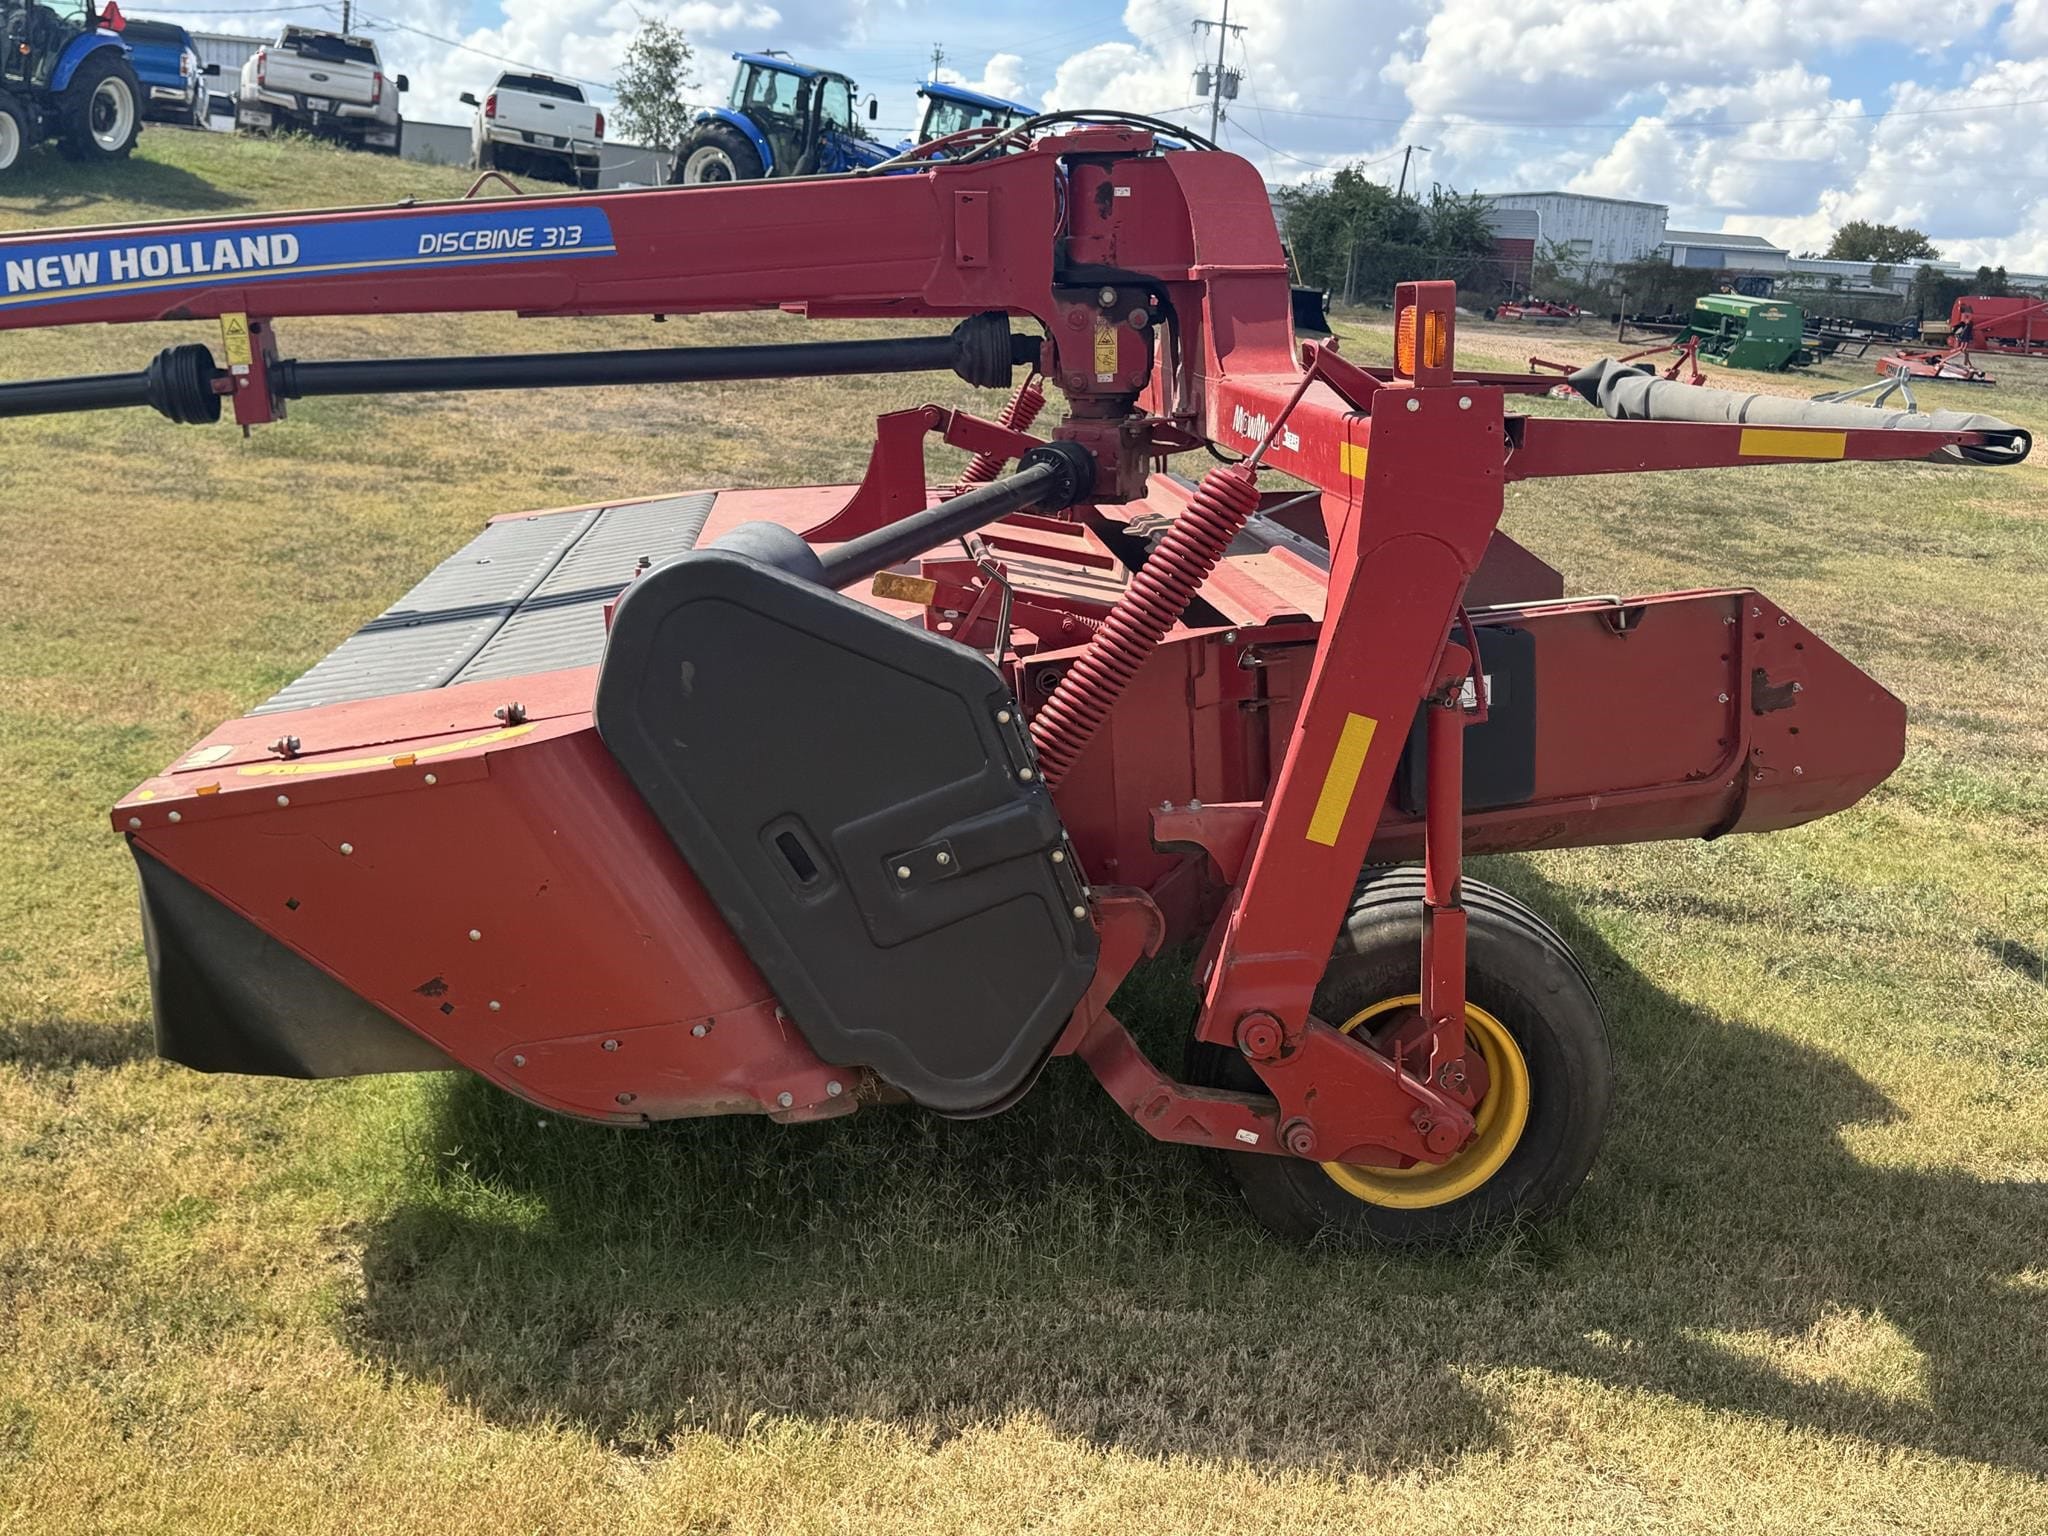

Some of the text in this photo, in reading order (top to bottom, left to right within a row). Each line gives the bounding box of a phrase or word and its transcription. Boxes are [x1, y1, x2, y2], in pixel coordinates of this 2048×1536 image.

[418, 225, 583, 254] DISCBINE 313
[6, 233, 299, 292] NEW HOLLAND
